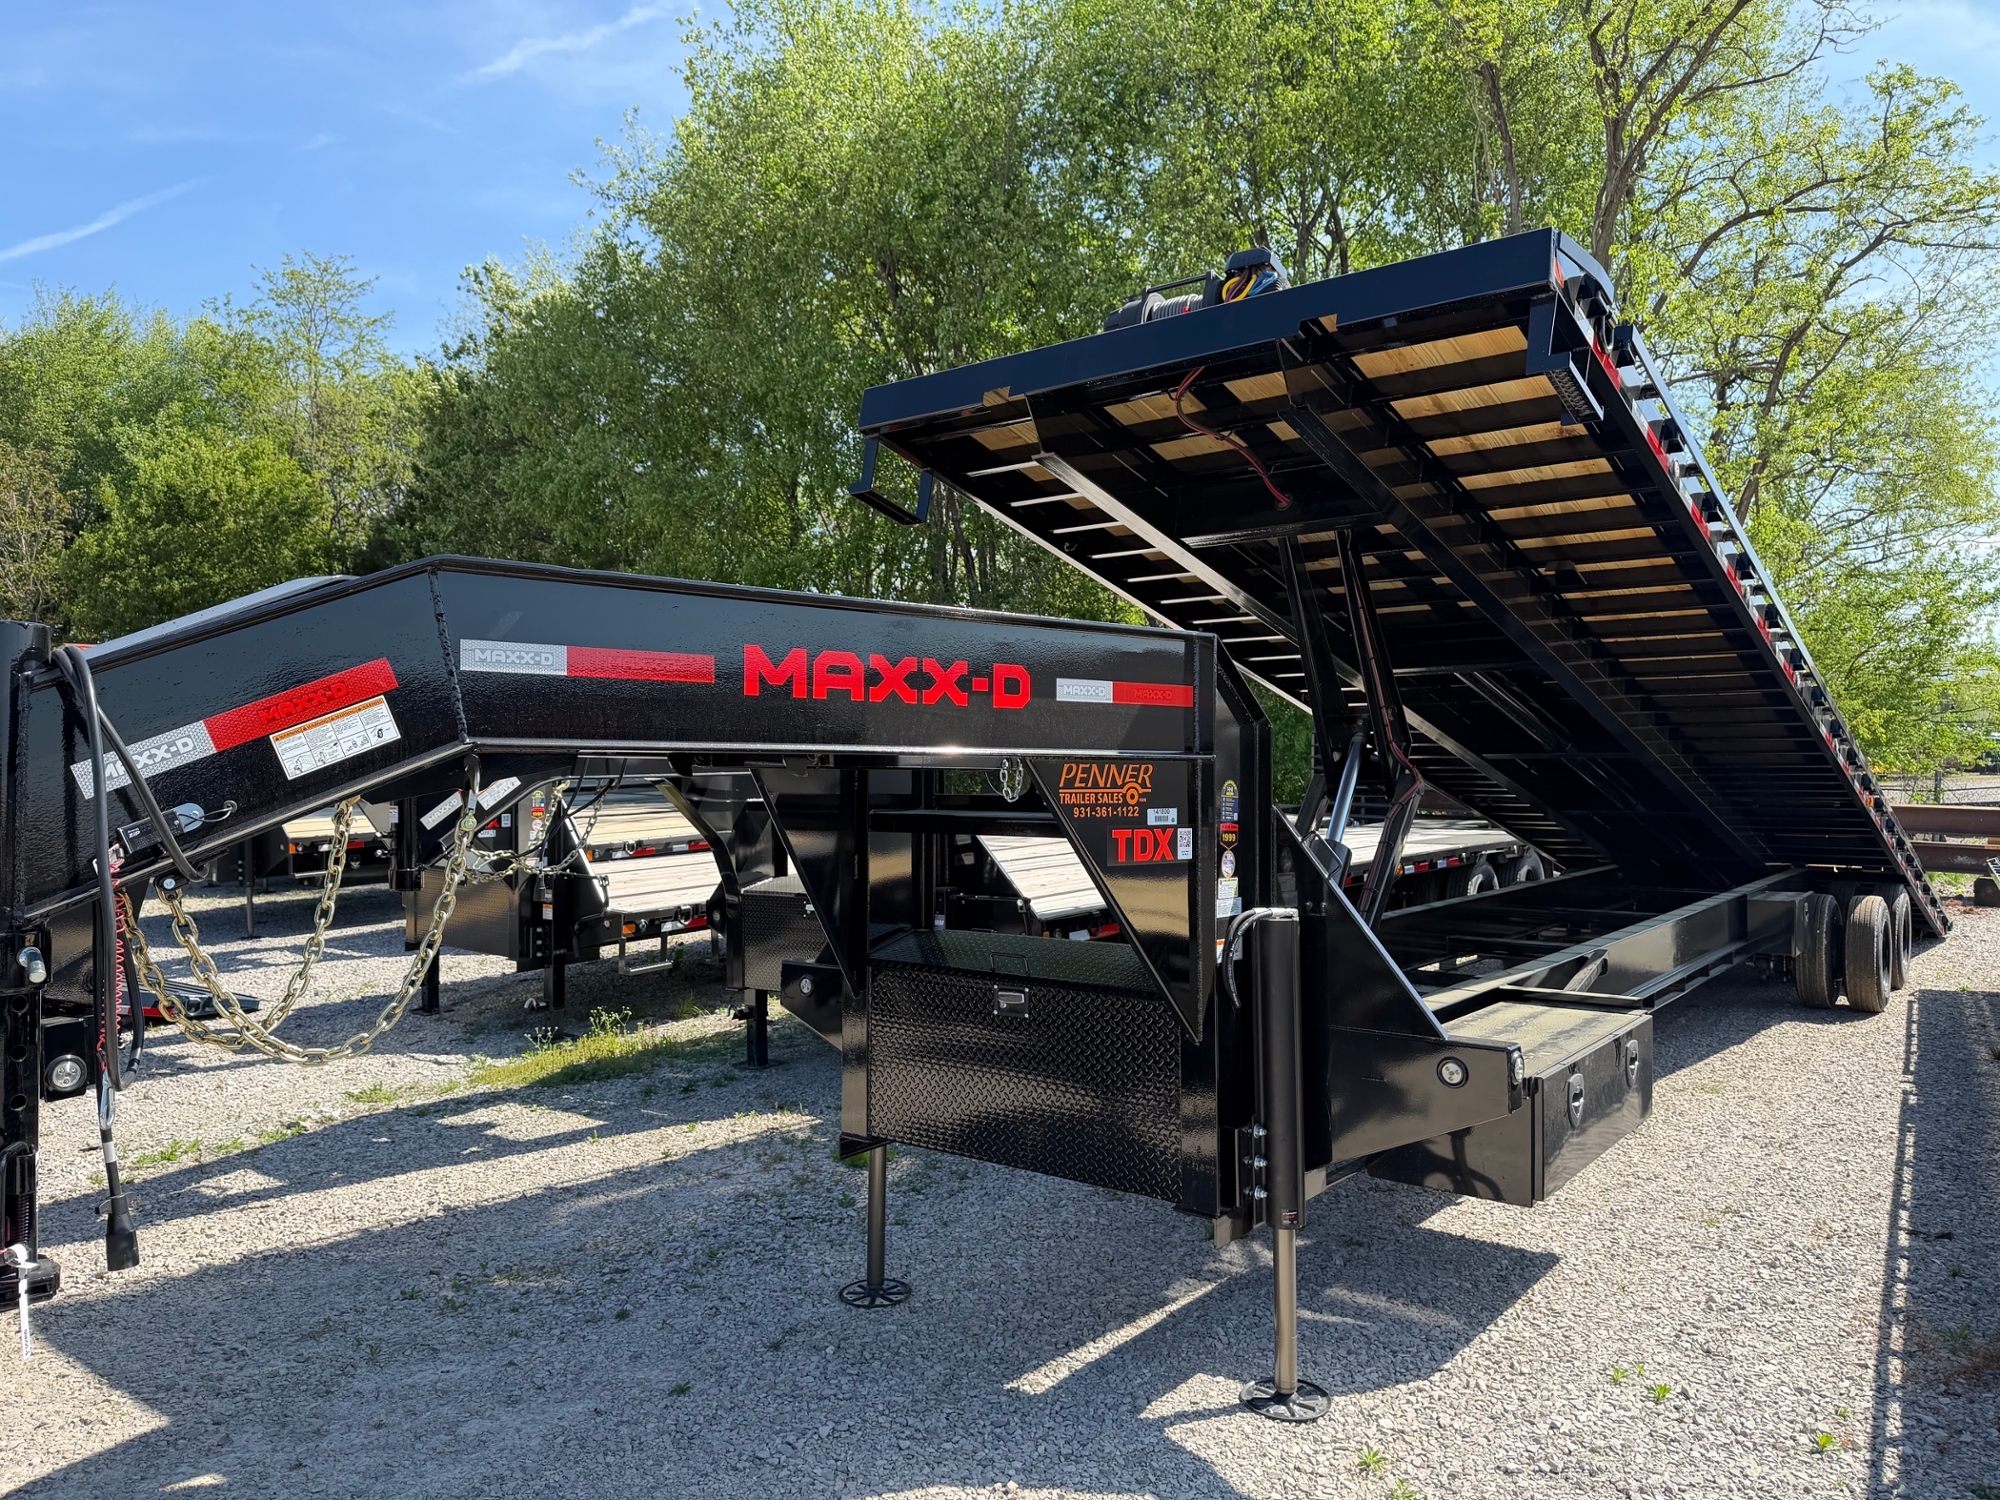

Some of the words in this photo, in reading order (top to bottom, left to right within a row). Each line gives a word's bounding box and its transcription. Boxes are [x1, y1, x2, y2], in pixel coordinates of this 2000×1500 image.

[474, 648, 554, 666] MAXX-D
[607, 655, 677, 670] MAXX-D
[743, 643, 1032, 710] MAXX-D
[1063, 683, 1106, 698] MAXX-D
[1133, 688, 1173, 701] MAXX-D
[259, 682, 348, 724] MAXX-D
[1059, 763, 1154, 788] PENNER
[1059, 793, 1096, 805] TRAILER
[1097, 793, 1123, 804] SALES
[428, 798, 458, 824] MAXX-D
[1073, 806, 1140, 818] 931-361-1122
[1111, 827, 1175, 863] TDX
[1221, 832, 1237, 842] 1999
